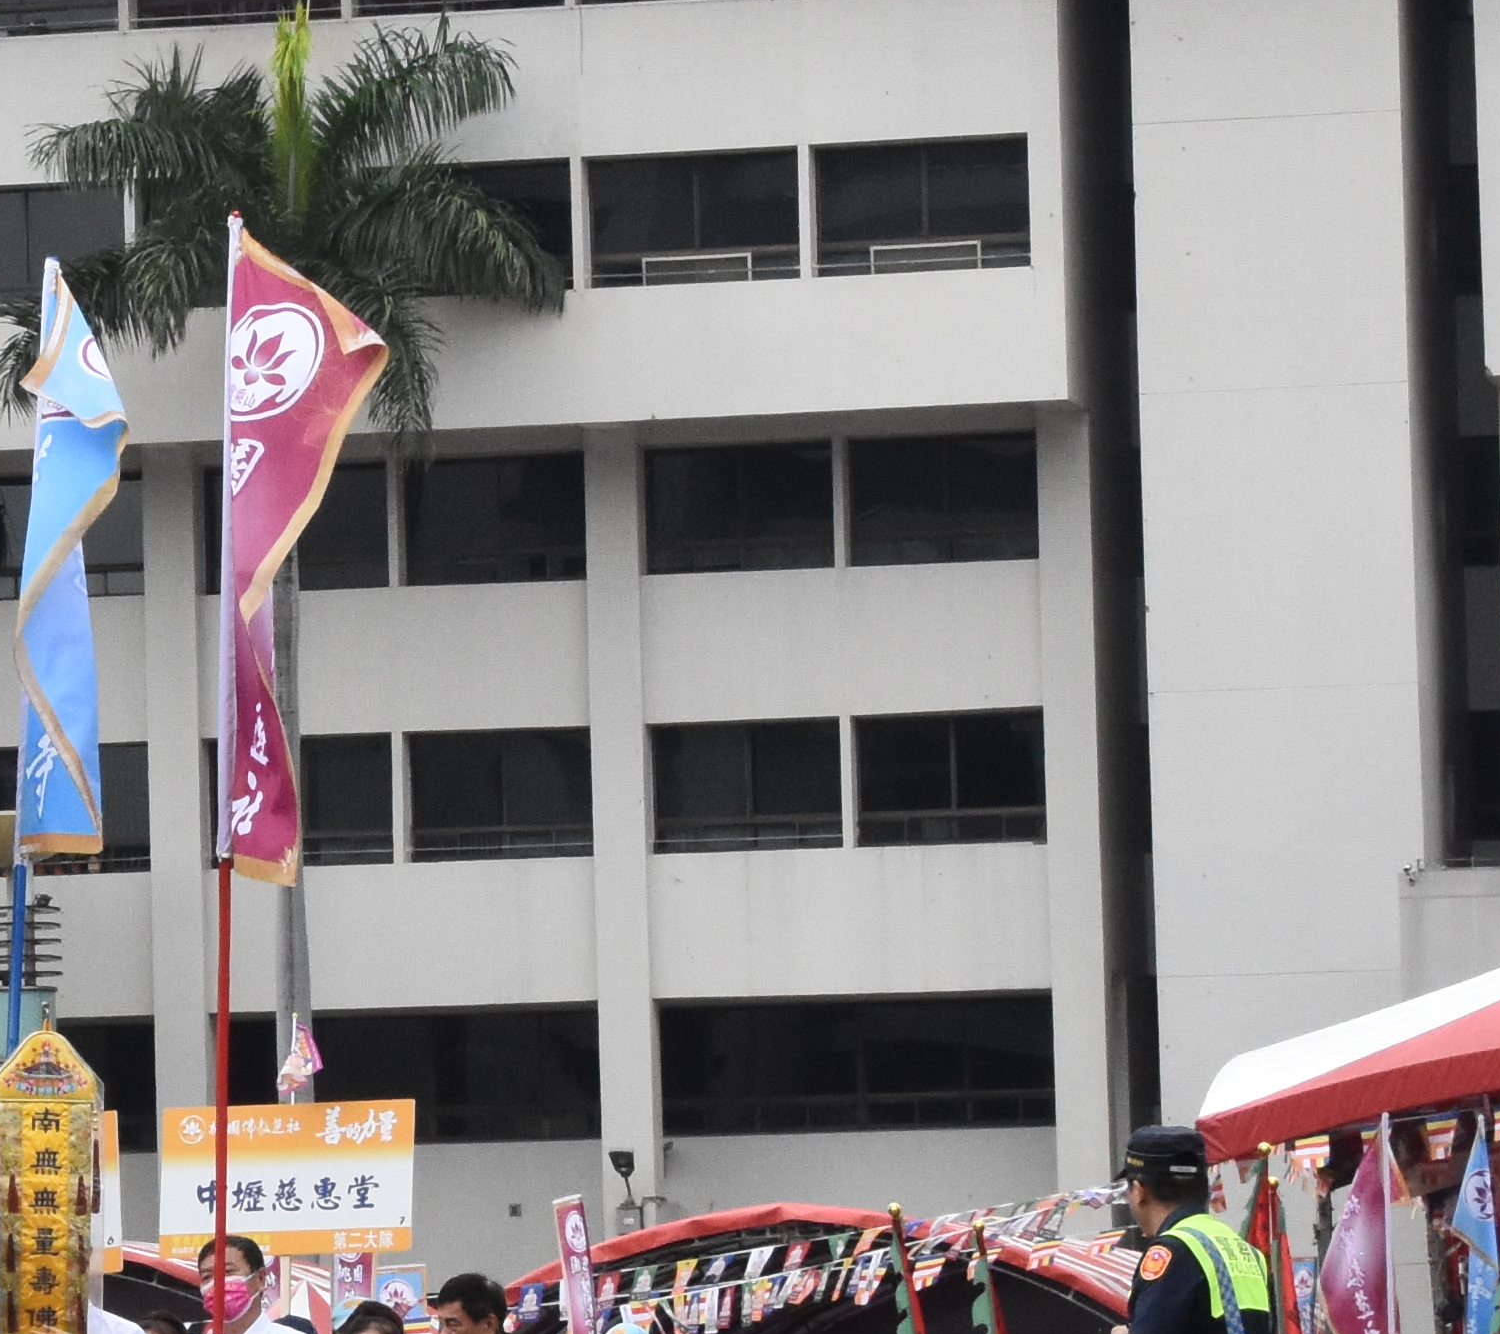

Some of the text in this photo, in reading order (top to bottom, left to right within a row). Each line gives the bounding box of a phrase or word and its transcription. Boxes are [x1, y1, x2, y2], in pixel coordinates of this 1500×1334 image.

[316, 1105, 398, 1145] 善的力量
[26, 1106, 64, 1333] 南無無量壽佛
[333, 1229, 395, 1251] 第二大隊
